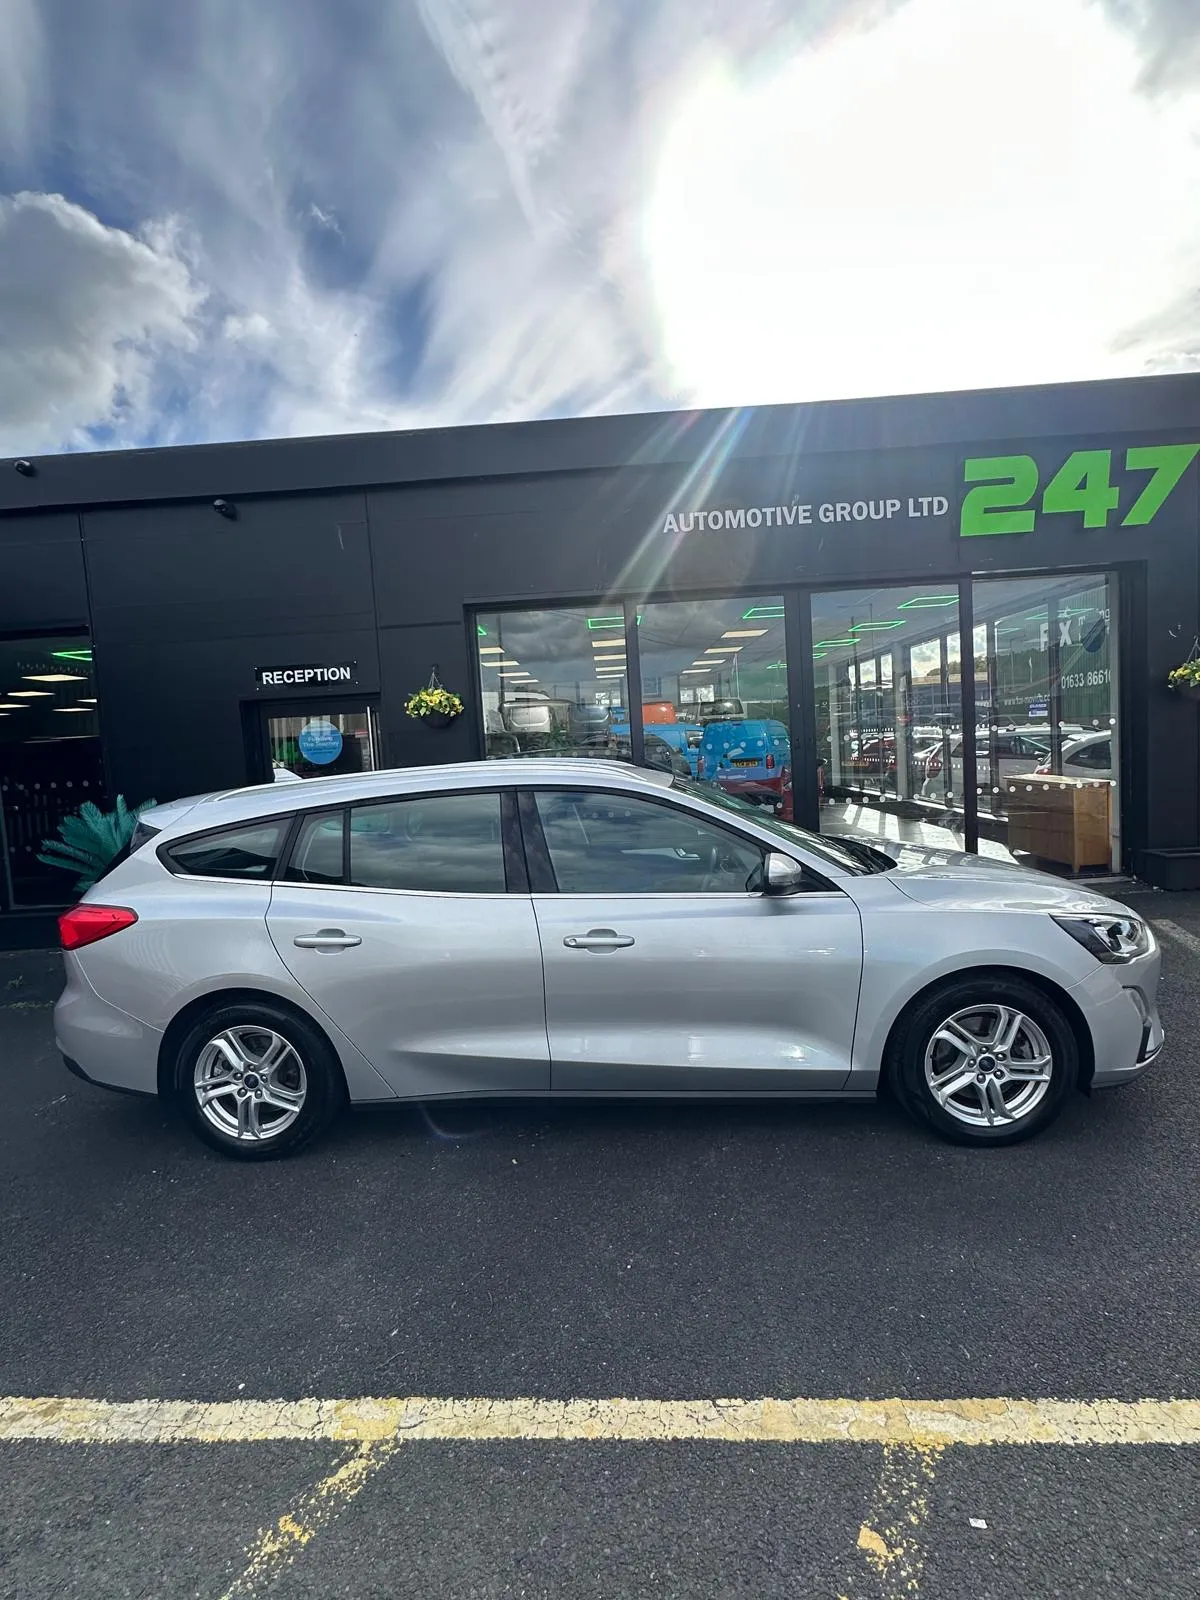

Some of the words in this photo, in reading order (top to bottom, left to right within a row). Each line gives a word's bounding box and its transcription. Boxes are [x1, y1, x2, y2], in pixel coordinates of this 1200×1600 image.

[663, 505, 812, 533] AUTOMOTIVE
[819, 500, 901, 522] GROUP
[907, 496, 948, 519] LTD
[961, 444, 1200, 537] 247
[1040, 619, 1072, 652] FX
[262, 667, 351, 685] RECEPTION
[1061, 673, 1084, 689] 01633
